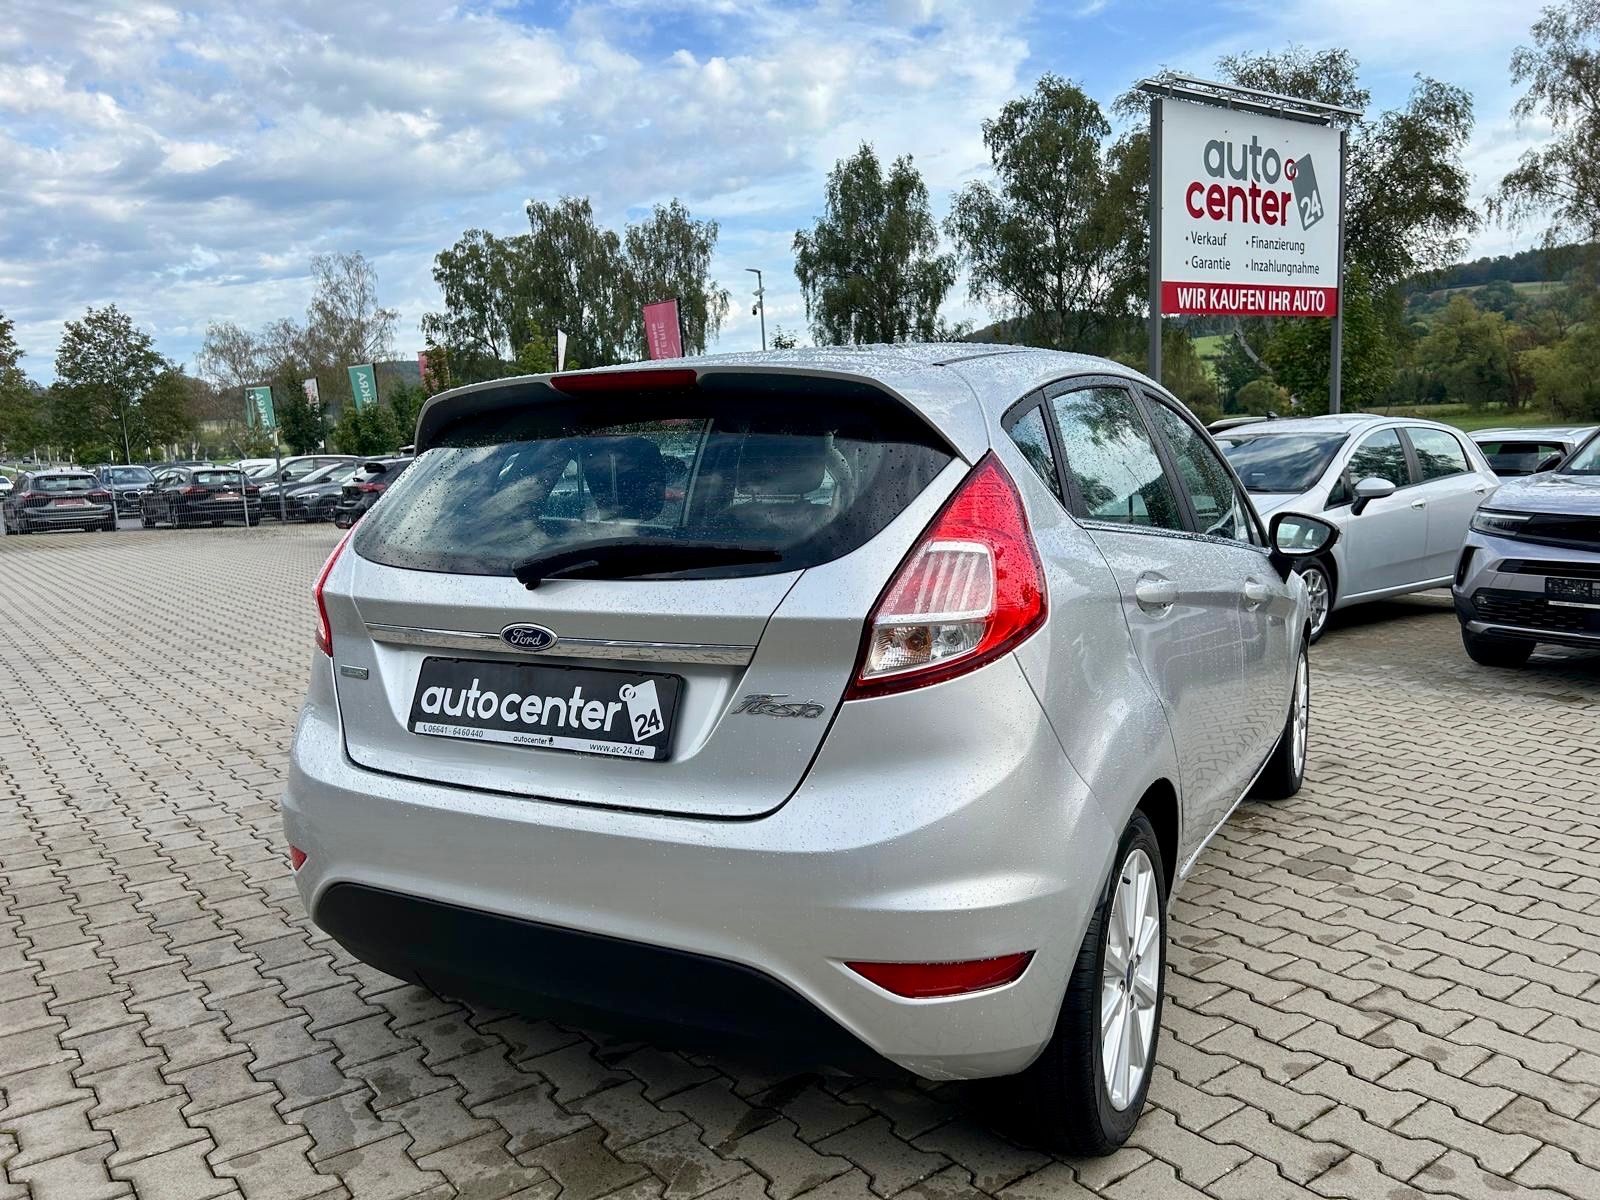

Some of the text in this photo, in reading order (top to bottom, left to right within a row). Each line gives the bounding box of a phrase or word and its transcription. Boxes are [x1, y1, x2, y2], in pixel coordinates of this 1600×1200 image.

[1203, 136, 1281, 184] auto
[1186, 181, 1291, 226] center
[1300, 191, 1322, 225] 24
[1190, 231, 1227, 247] Verkauf
[1251, 235, 1305, 255] Finanzierung
[1191, 255, 1231, 270] Garantie
[1251, 258, 1320, 276] Inzahlungnahme
[1177, 287, 1326, 312] WIR KAUFEN IHR AUTO
[510, 628, 542, 646] Ford
[731, 692, 825, 719] Fiesta
[634, 713, 661, 738] 24
[589, 743, 645, 756] www.ac-24.de
